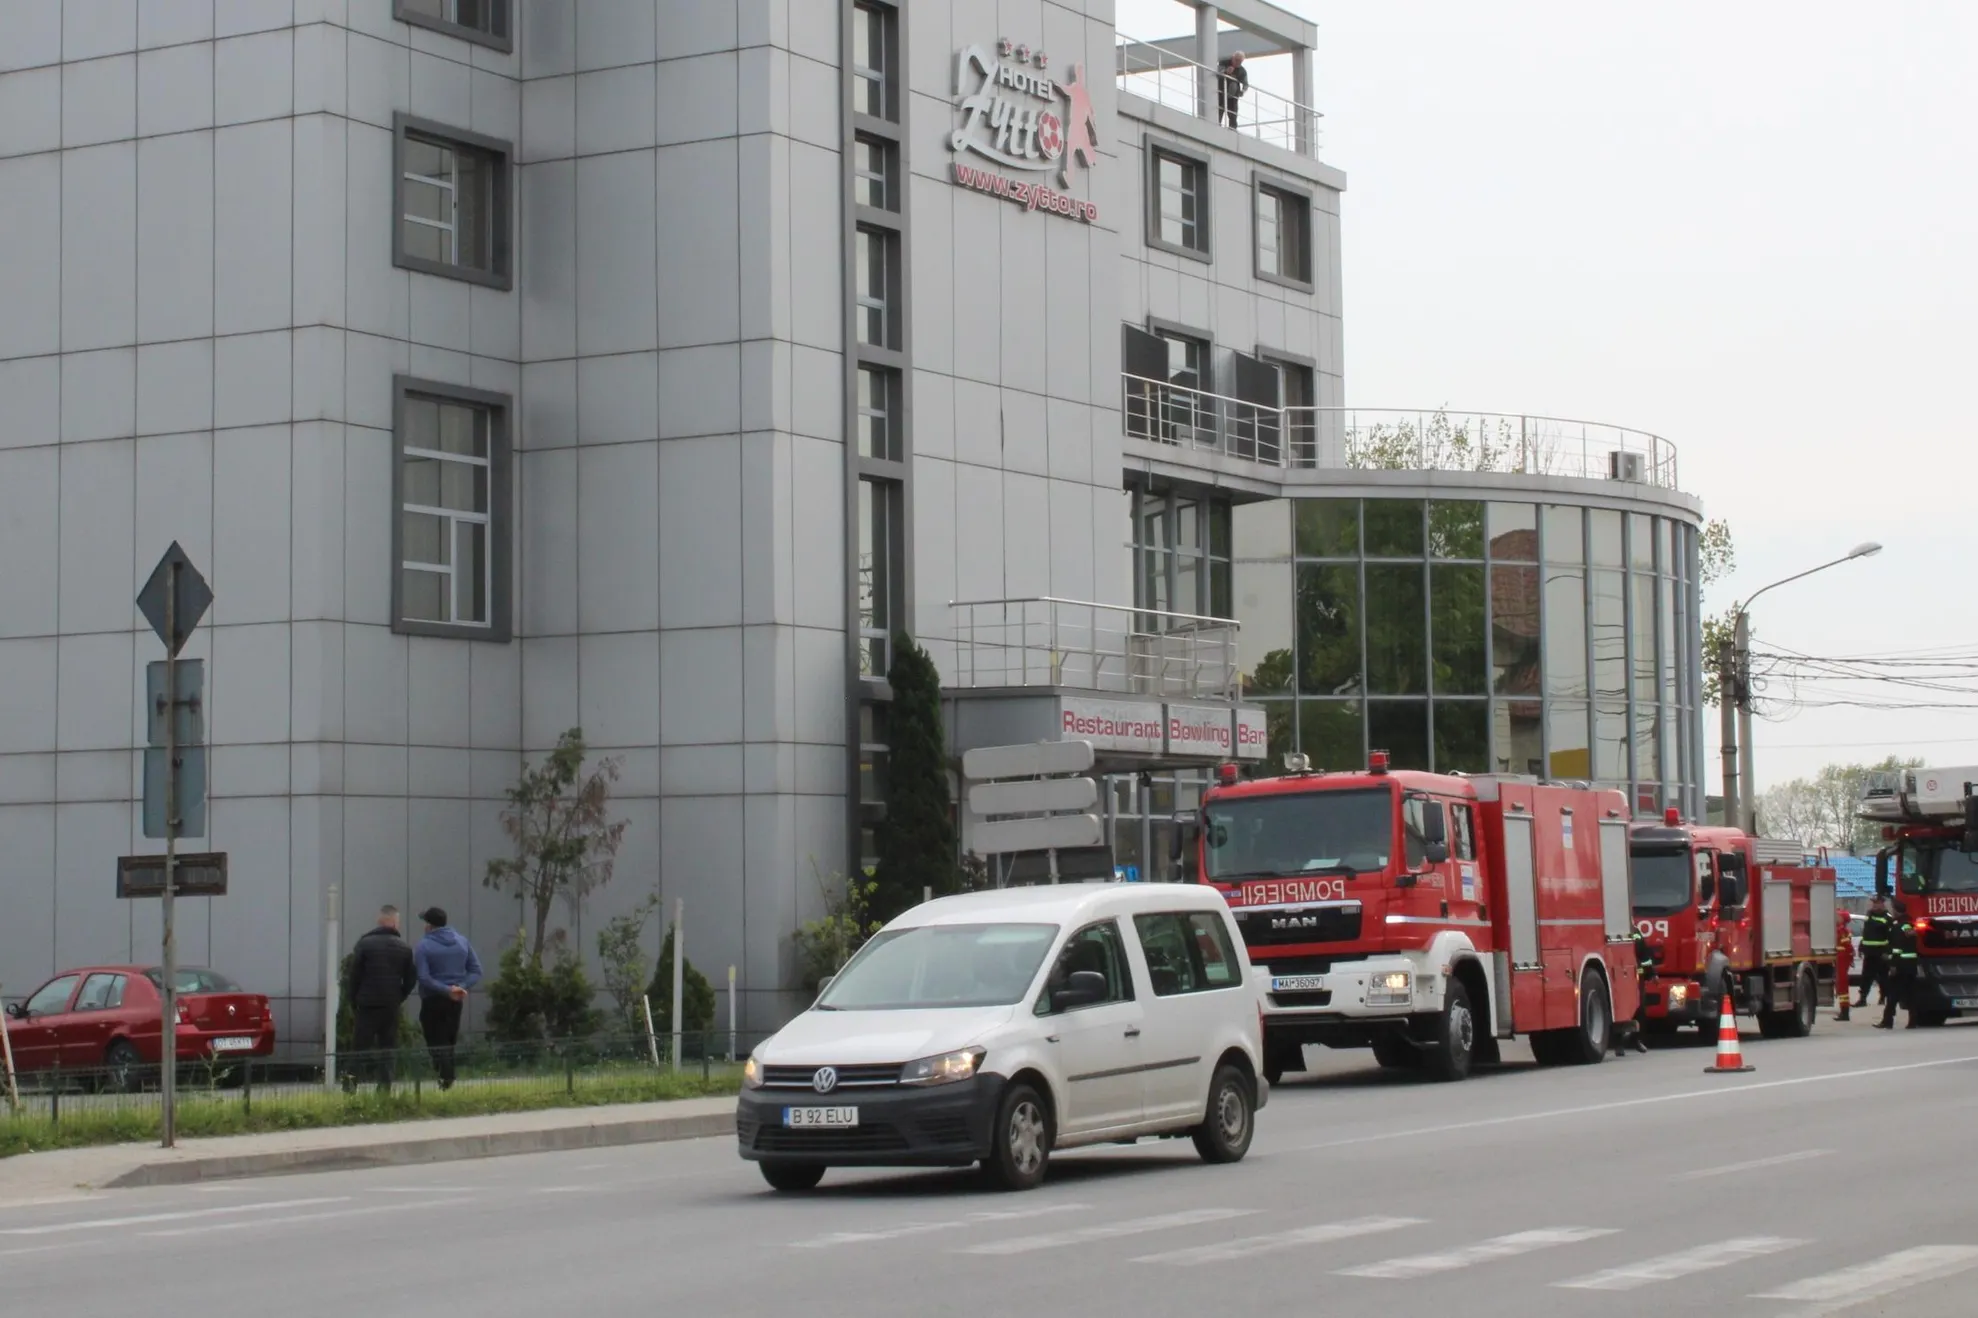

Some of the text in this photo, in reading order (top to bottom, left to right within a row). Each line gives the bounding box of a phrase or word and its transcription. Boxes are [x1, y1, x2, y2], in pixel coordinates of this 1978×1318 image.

[1000, 67, 1055, 101] HOTEL
[956, 163, 1098, 220] www.zytto.ro
[1062, 710, 1265, 748] Restaurant Bowling Bar
[1271, 916, 1318, 929] MAN
[793, 1108, 853, 1124] B 92 ELU
